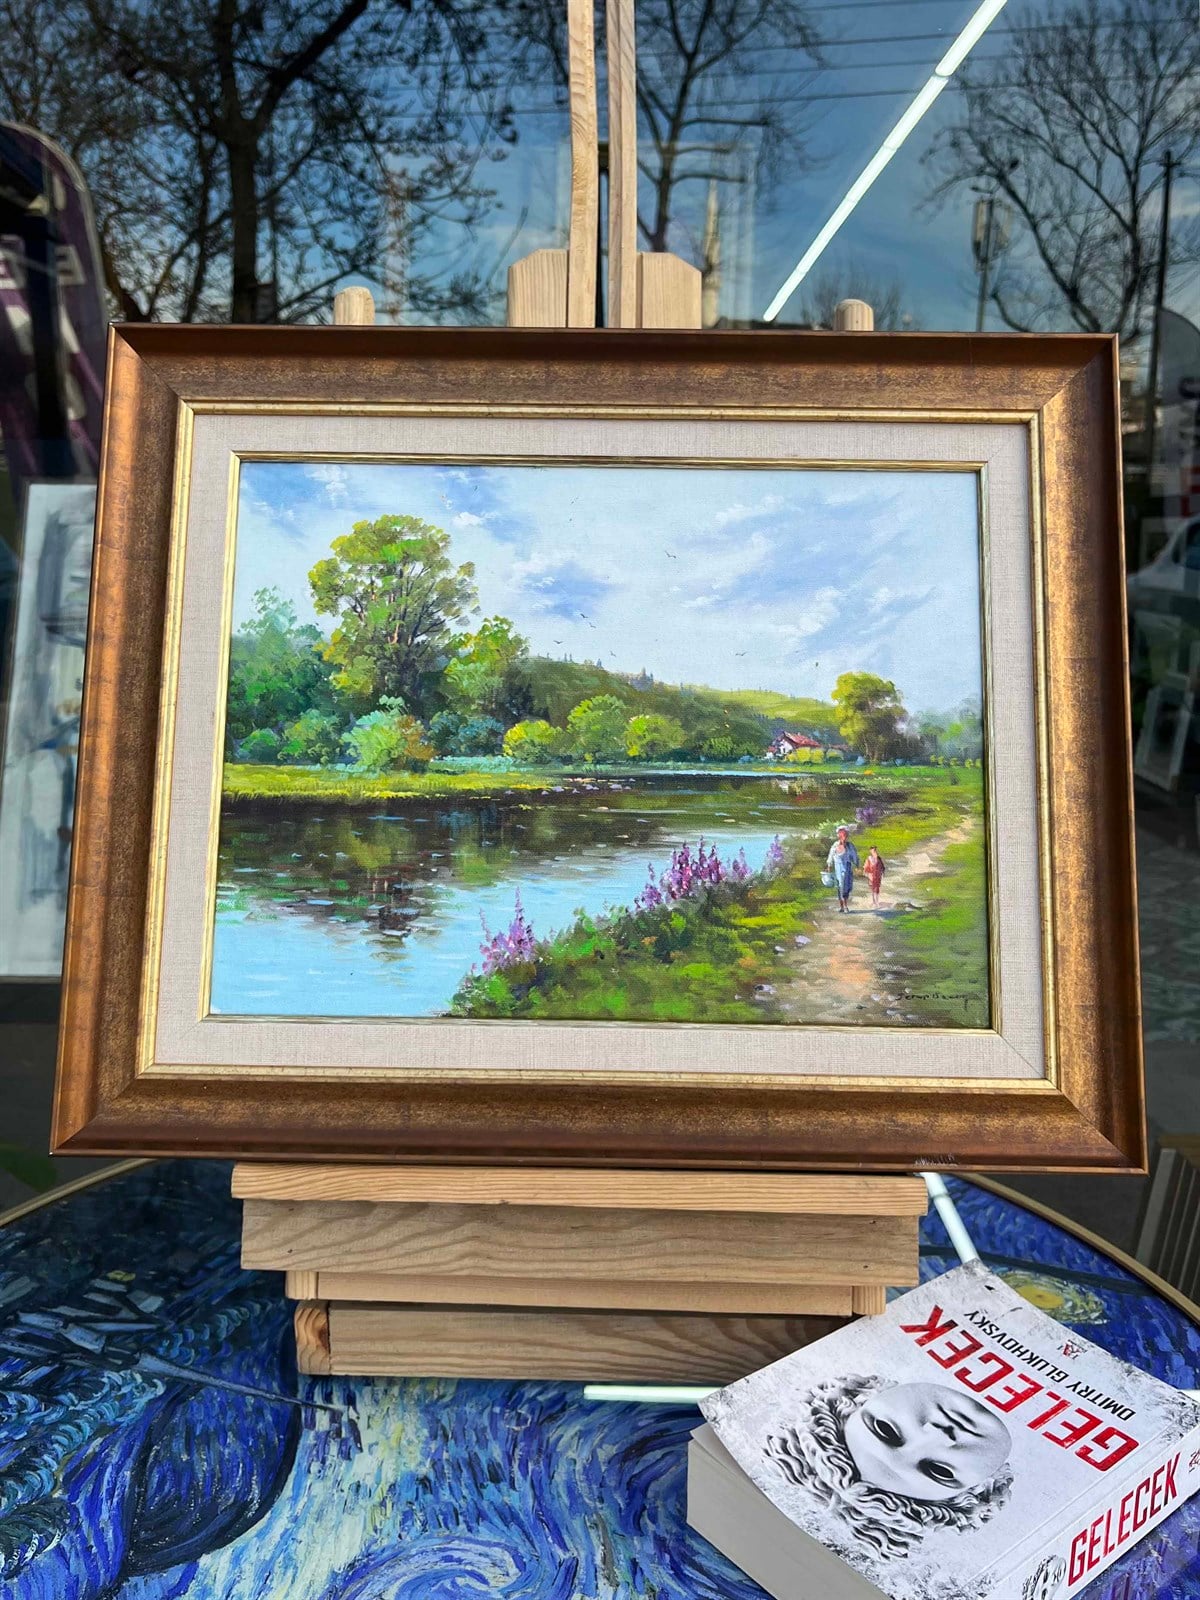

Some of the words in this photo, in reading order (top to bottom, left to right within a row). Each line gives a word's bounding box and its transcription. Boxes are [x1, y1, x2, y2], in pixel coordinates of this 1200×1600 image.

[900, 1305, 1139, 1471] GELECEK
[965, 1310, 1069, 1382] GLUKHOVSKY
[1066, 1381, 1136, 1421] DMITRY
[1068, 1452, 1181, 1587] GELECEK
